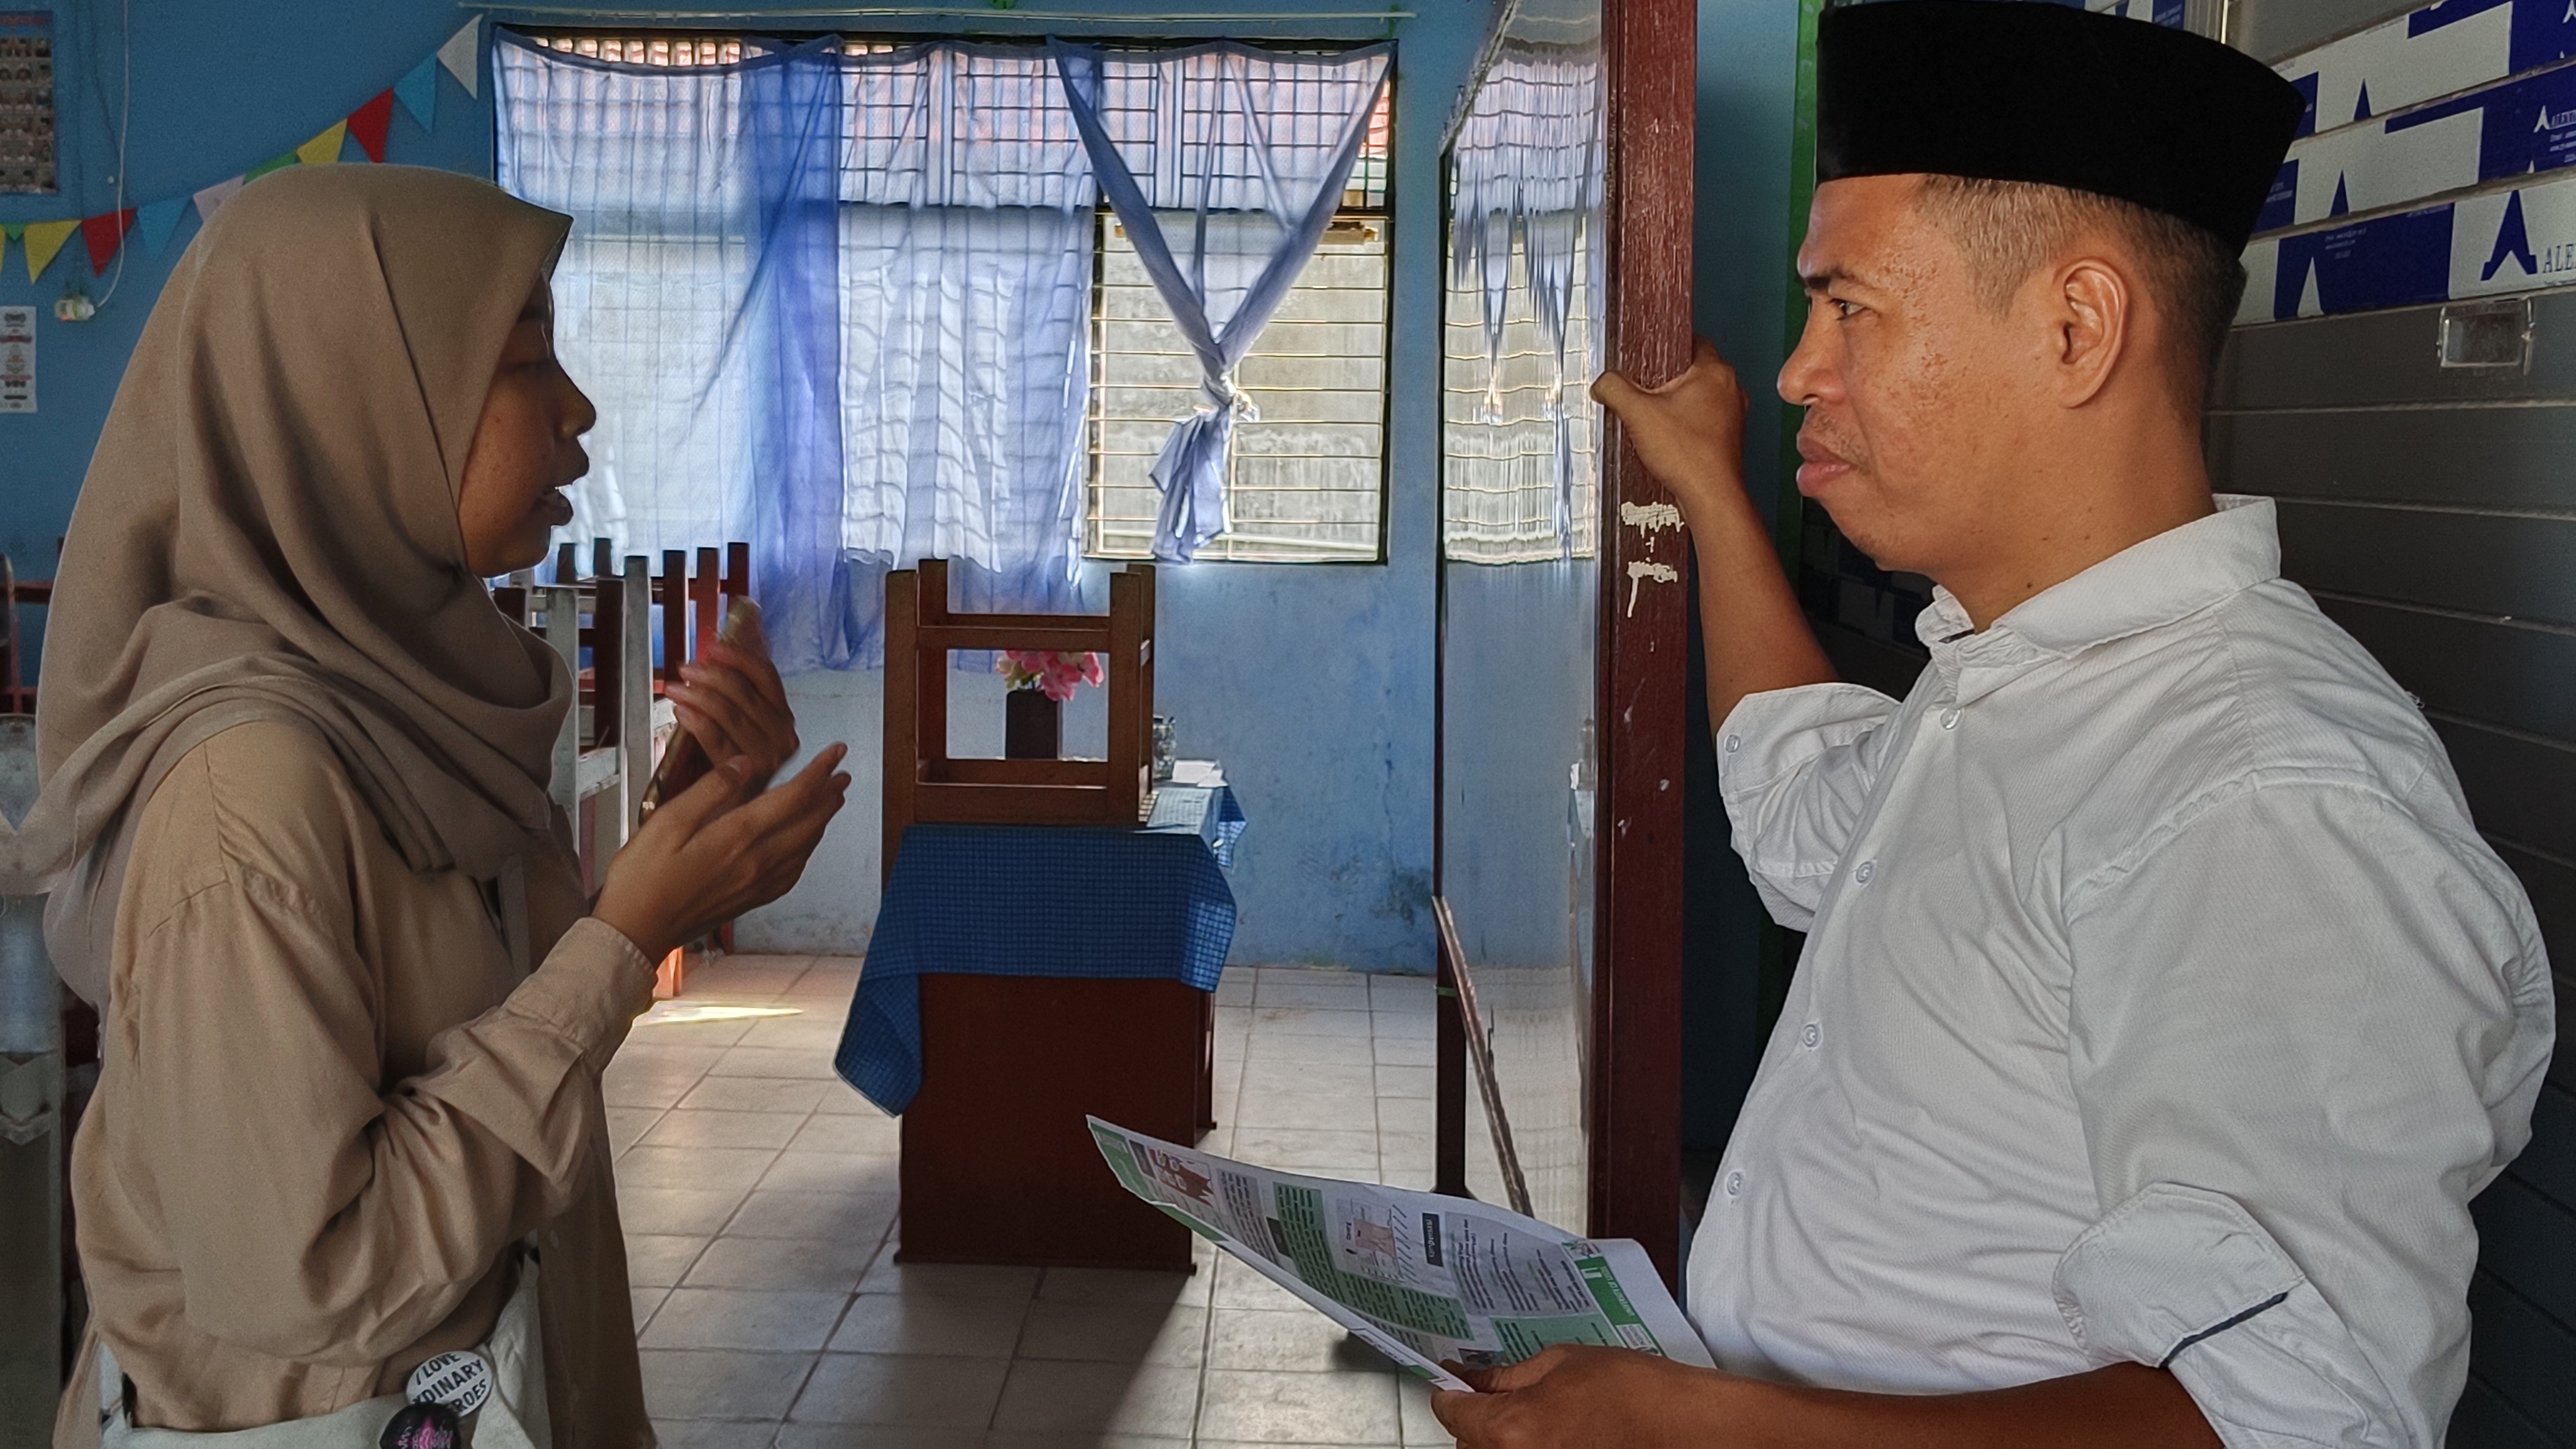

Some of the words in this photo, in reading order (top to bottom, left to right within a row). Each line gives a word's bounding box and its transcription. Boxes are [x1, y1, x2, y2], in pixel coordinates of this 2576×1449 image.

[2543, 243, 2576, 274] ALE
[415, 1372, 421, 1386] I
[423, 1353, 462, 1379] LOVE
[451, 1378, 487, 1412] ROES
